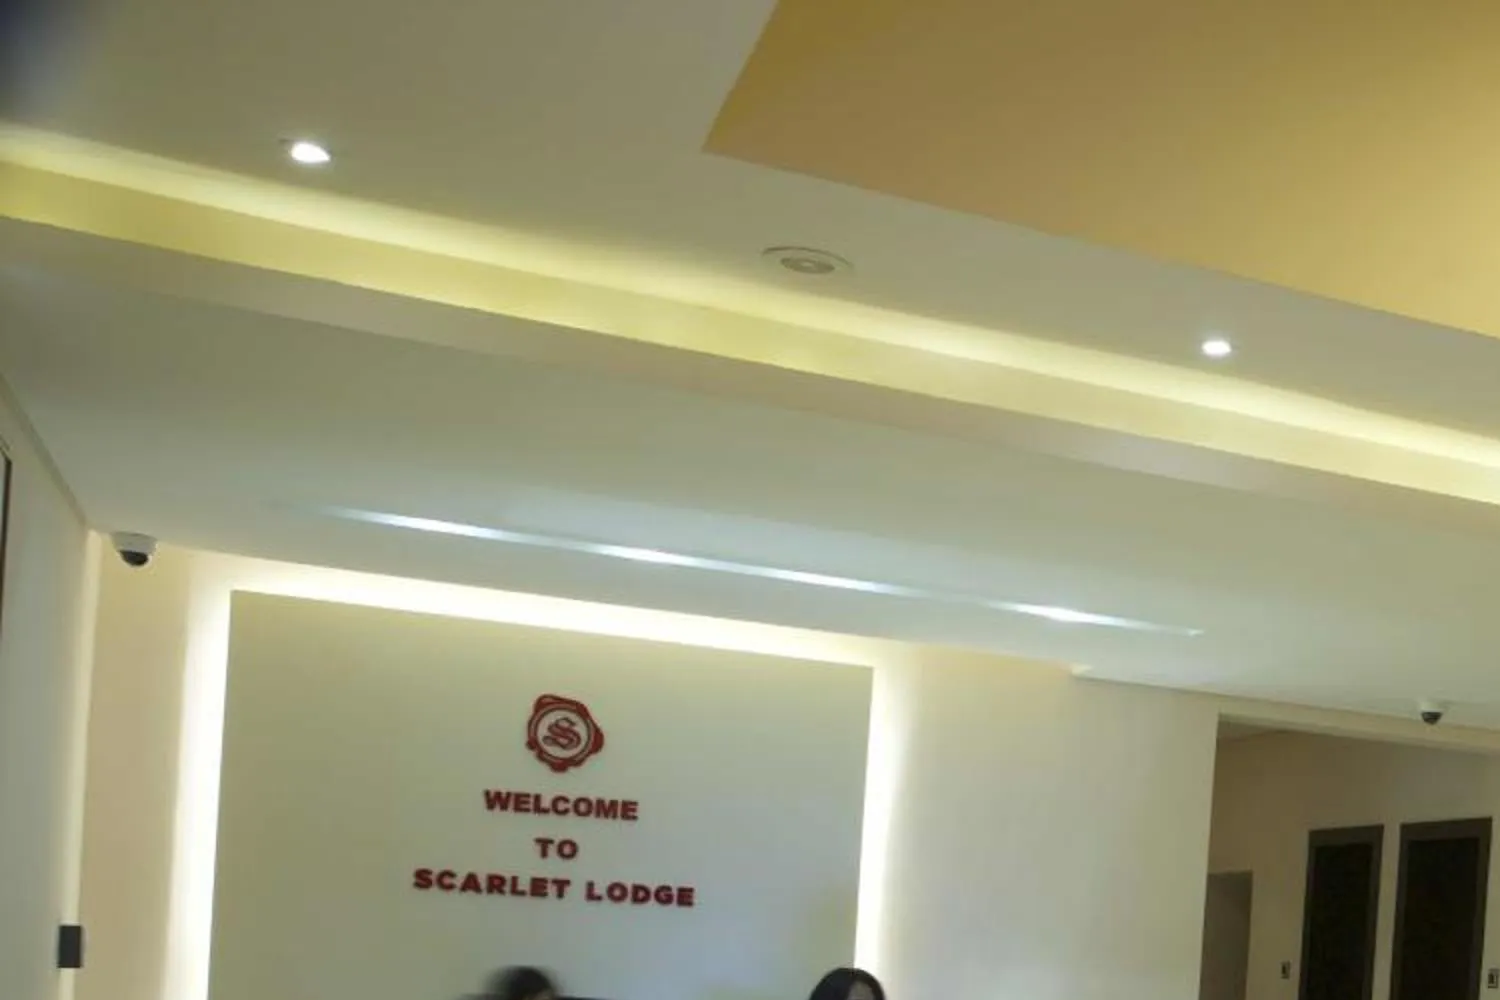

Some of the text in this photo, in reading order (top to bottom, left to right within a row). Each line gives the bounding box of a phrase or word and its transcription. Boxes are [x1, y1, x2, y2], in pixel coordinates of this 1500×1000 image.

[483, 789, 639, 821] WELCOME
[534, 837, 579, 860] TO
[412, 868, 695, 907] SCARLET LODGE
